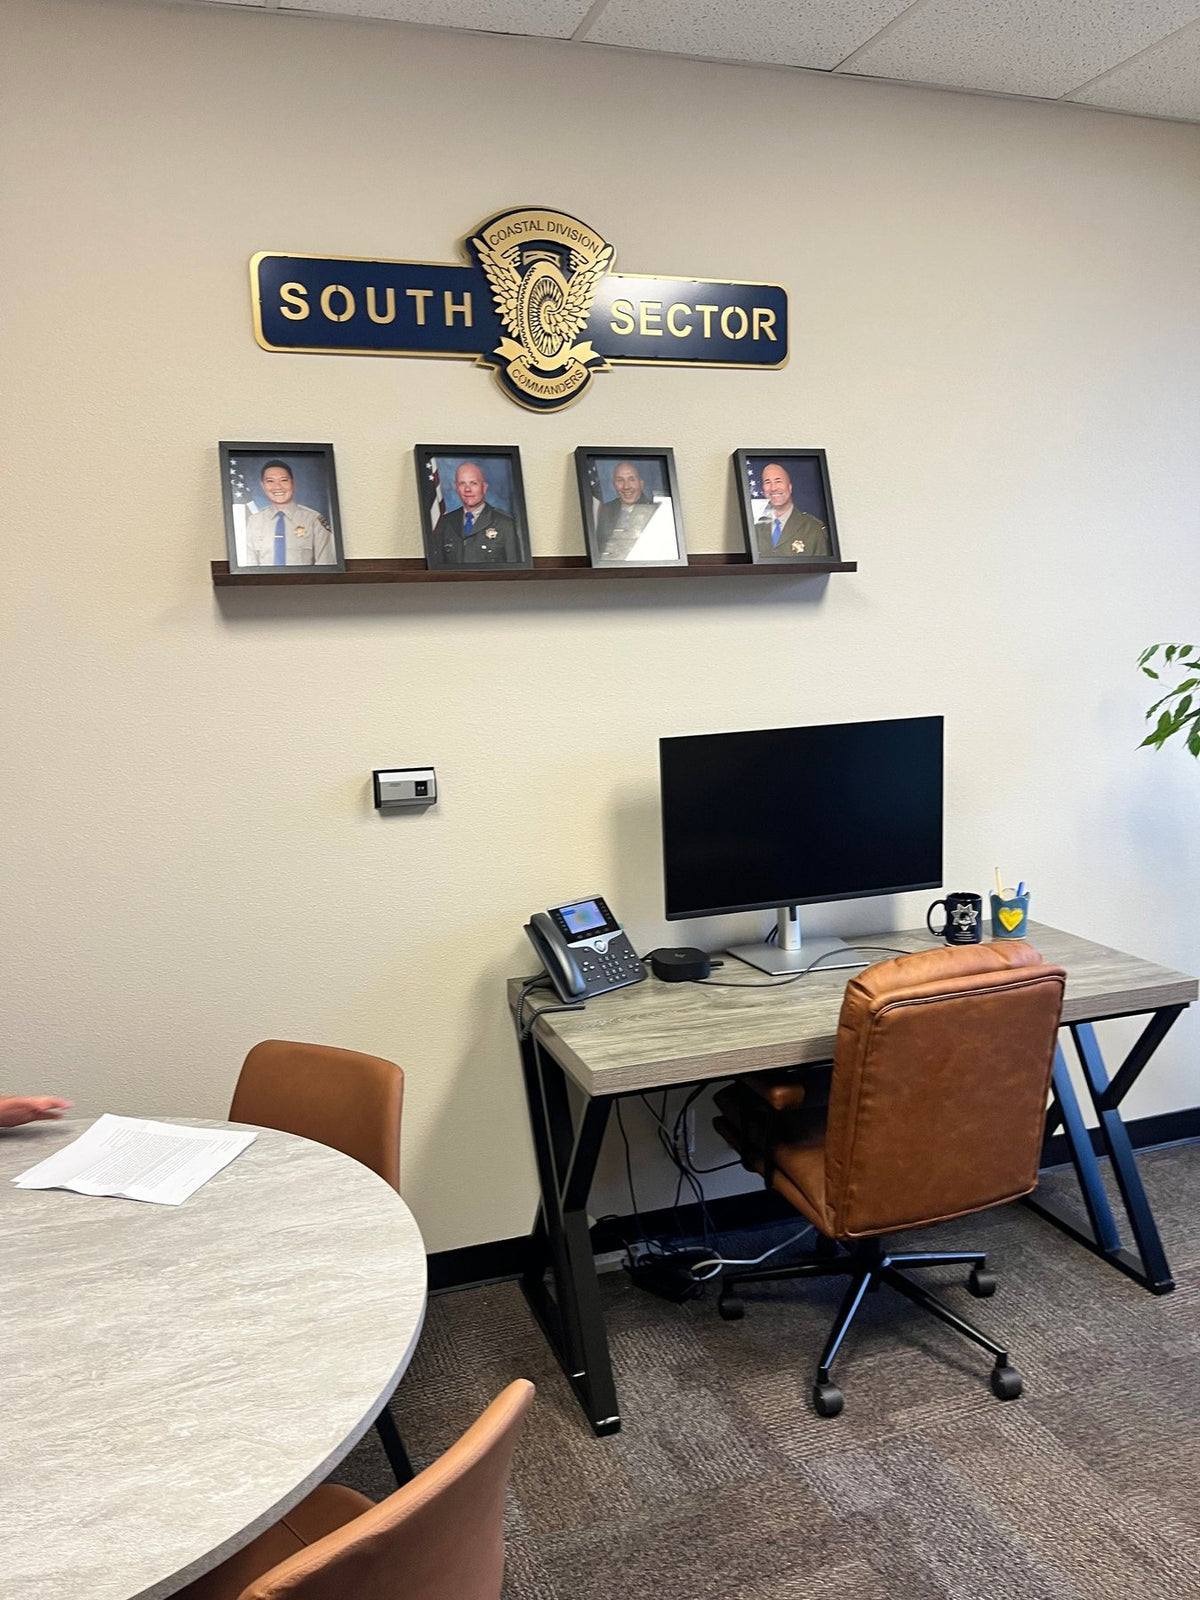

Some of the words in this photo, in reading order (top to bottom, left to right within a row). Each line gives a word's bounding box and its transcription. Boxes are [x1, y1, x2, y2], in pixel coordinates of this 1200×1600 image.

[489, 220, 544, 246] COASTAL
[546, 221, 600, 254] DIVISION
[279, 282, 473, 327] SOUTH
[610, 299, 777, 342] SECTOR
[511, 368, 585, 395] COMMANDERS
